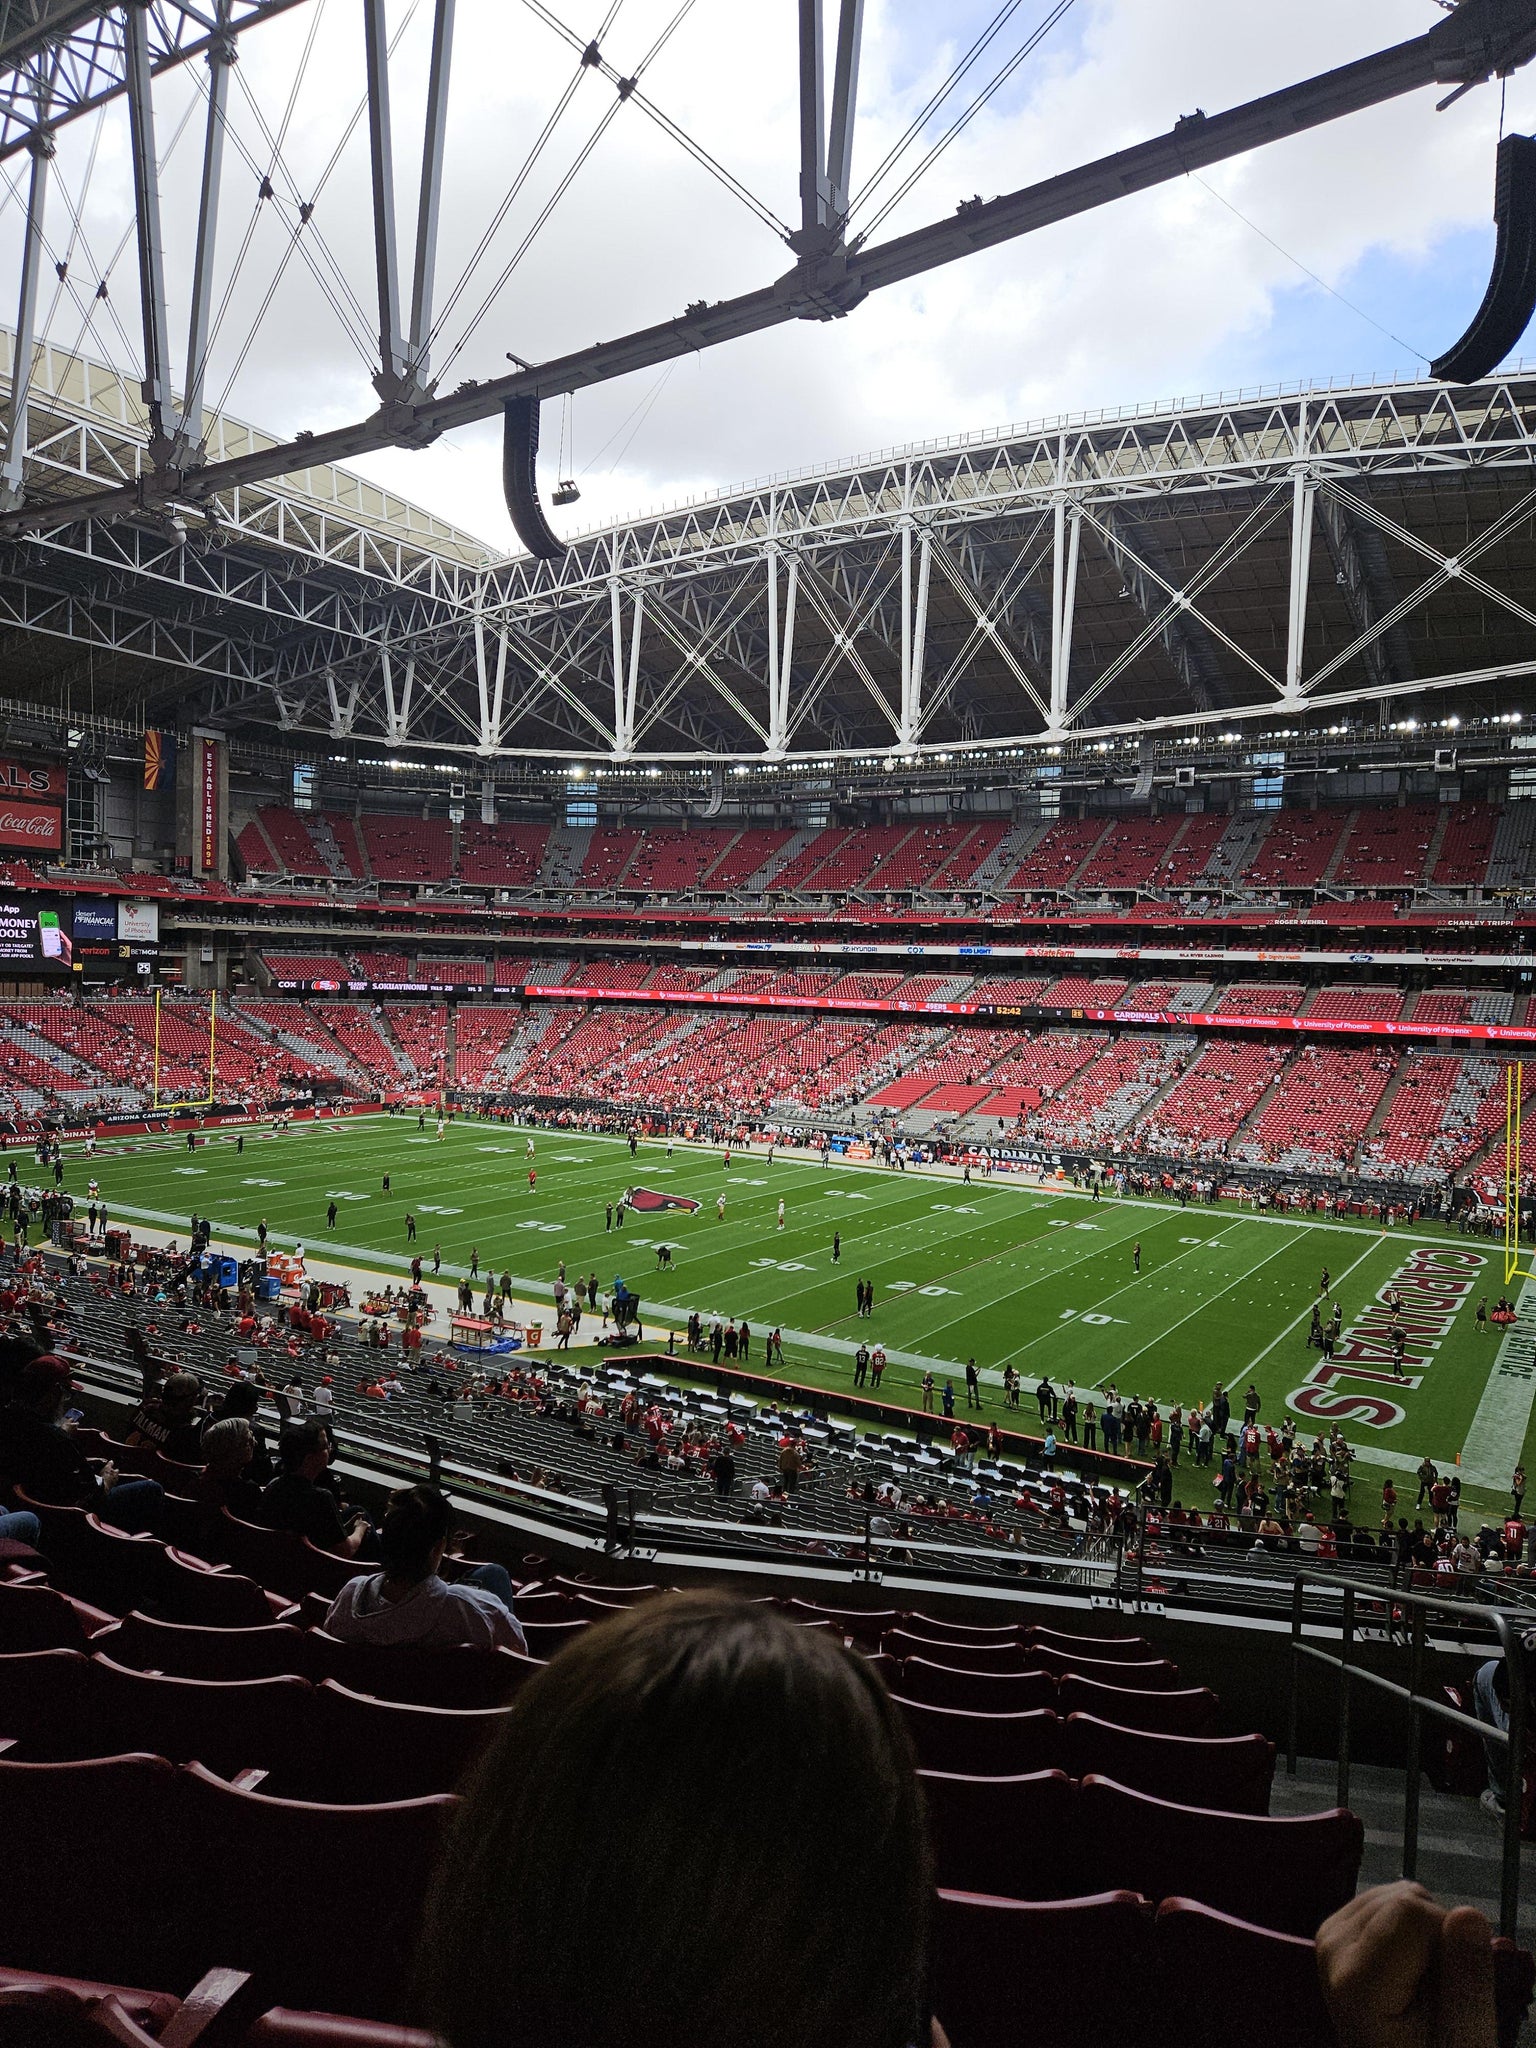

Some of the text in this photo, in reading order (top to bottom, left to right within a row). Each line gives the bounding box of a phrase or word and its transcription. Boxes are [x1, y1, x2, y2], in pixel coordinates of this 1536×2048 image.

[0, 766, 50, 792] LS
[205, 753, 213, 835] ESTABLISHED
[0, 812, 55, 837] Coca-Cola
[4, 905, 20, 915] App
[960, 1005, 967, 1013] 0
[996, 1007, 1021, 1015] 52:42
[1114, 1011, 1159, 1019] CARDINALS
[1216, 1017, 1245, 1026] University
[1304, 1021, 1335, 1030] University
[1399, 1026, 1431, 1034] University
[1500, 1030, 1536, 1039] University
[143, 1111, 181, 1119] CARDINLS
[763, 1123, 812, 1137] ARIZO
[3, 1130, 95, 1144] RIZONA CADINALS
[969, 1146, 1061, 1165] CARDINALS
[824, 1190, 866, 1199] 40
[930, 1204, 978, 1214] 30
[515, 1220, 567, 1232] 50
[1047, 1220, 1102, 1231] 20
[626, 1239, 680, 1252] 40
[1178, 1237, 1222, 1247] 10
[748, 1258, 804, 1272] 30
[281, 1273, 287, 1281] G
[885, 1281, 949, 1297] 20
[1058, 1309, 1113, 1325] 10
[531, 1330, 539, 1340] G
[1284, 1248, 1489, 1430] CARDINALS
[858, 1355, 866, 1363] 13
[875, 1357, 884, 1365] 82
[1499, 1337, 1536, 1380] SERVICE
[132, 1410, 170, 1442] TILLMAN
[1247, 1434, 1256, 1443] 85
[1215, 1519, 1223, 1528] 21
[1510, 1528, 1517, 1539] 11
[1460, 1552, 1473, 1563] 52
